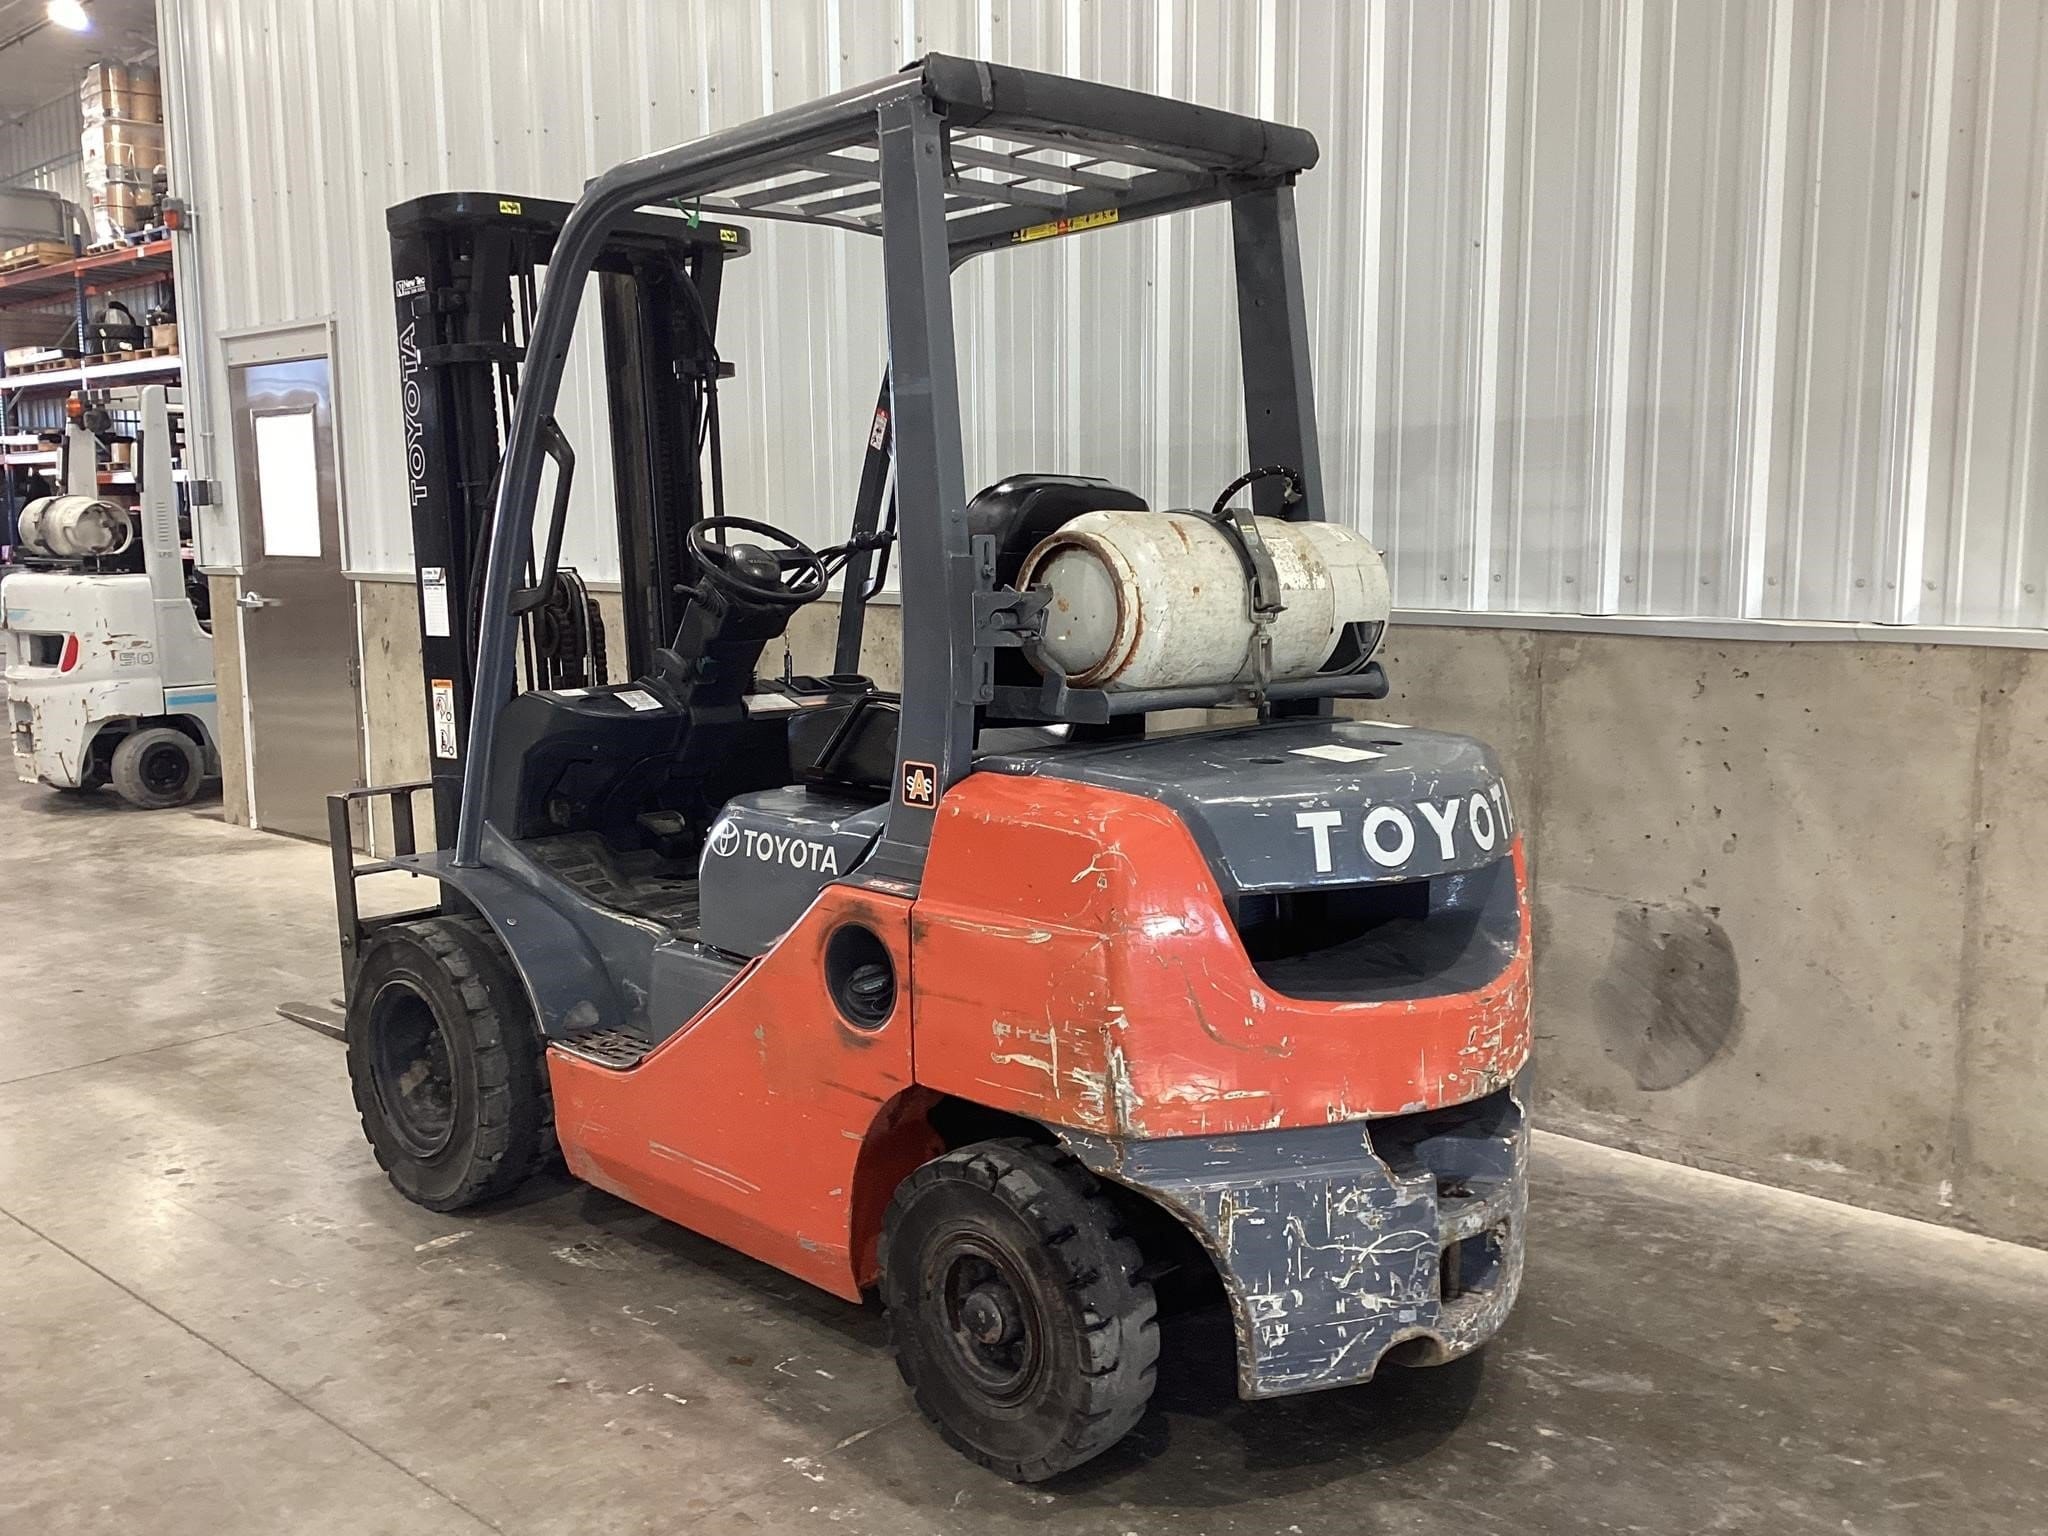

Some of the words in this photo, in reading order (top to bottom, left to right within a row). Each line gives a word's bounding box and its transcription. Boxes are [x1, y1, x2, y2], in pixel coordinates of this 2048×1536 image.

[401, 322, 427, 506] TOYOTA
[120, 652, 153, 666] 50
[744, 829, 838, 875] TOYOTA
